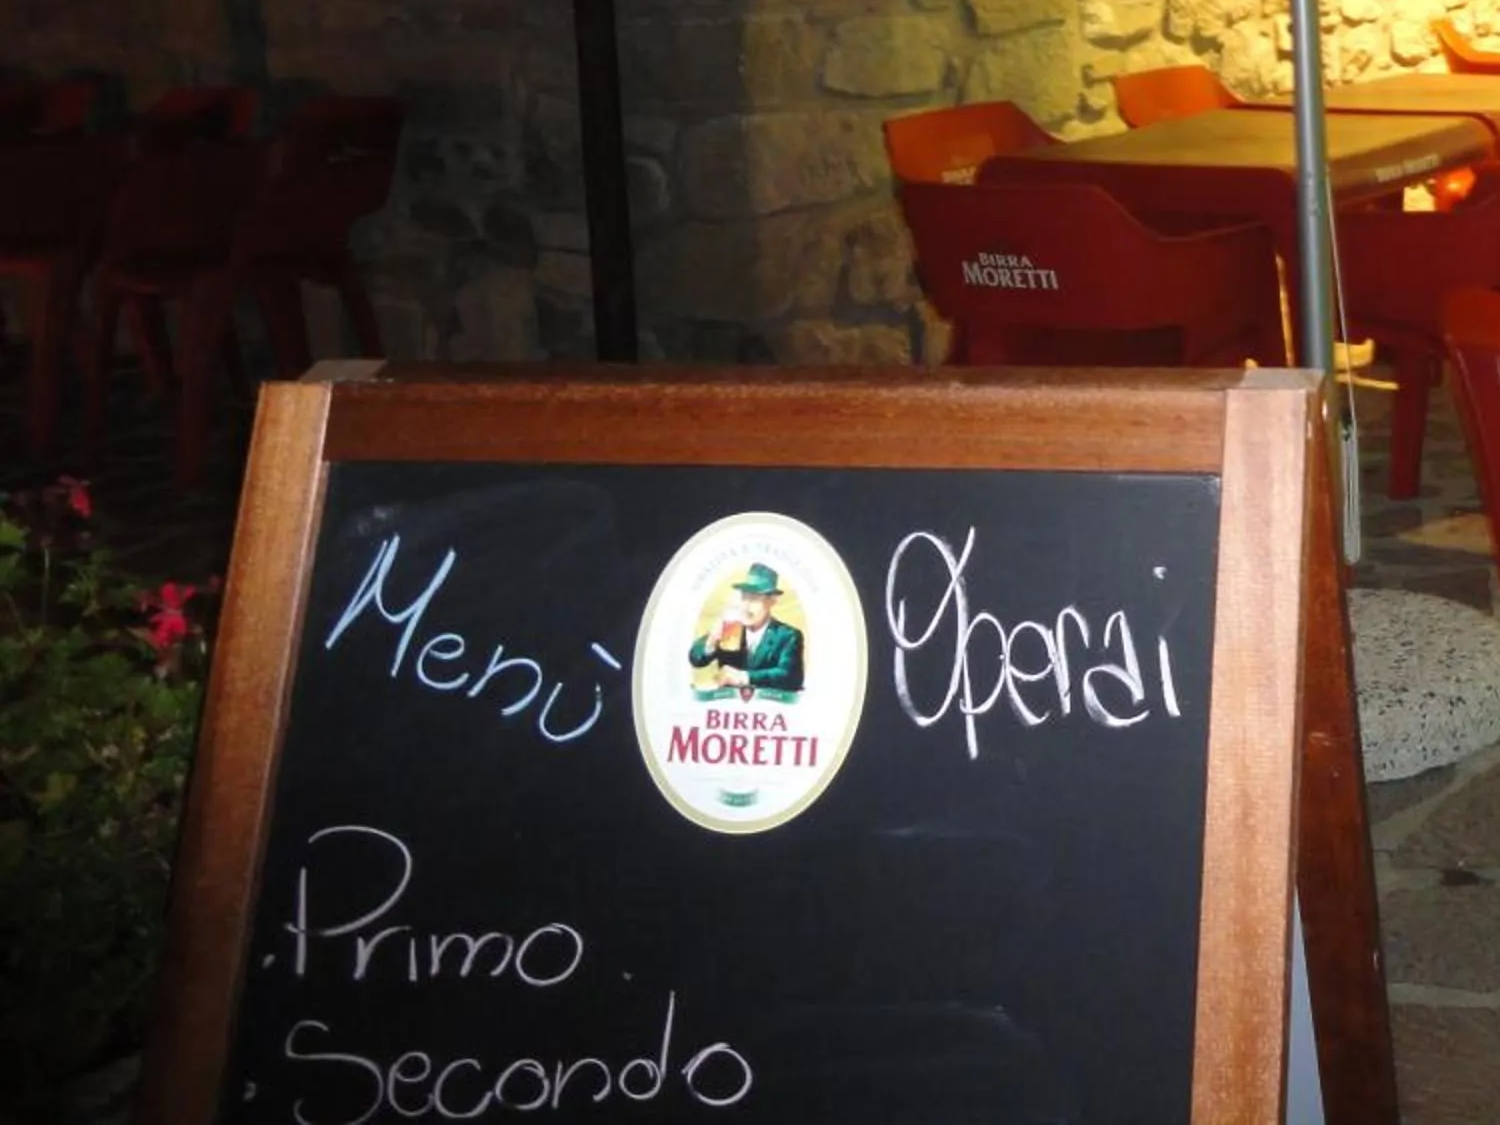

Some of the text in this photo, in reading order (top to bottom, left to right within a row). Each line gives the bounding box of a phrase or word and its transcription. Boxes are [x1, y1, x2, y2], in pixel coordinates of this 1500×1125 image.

[961, 260, 1059, 290] MORETTI
[978, 252, 1034, 268] BIRRA
[325, 533, 622, 741] Menù
[706, 708, 788, 732] BIRRA
[666, 726, 819, 768] MORETTI
[284, 825, 584, 987] Primo
[284, 990, 752, 1125] Secondo
